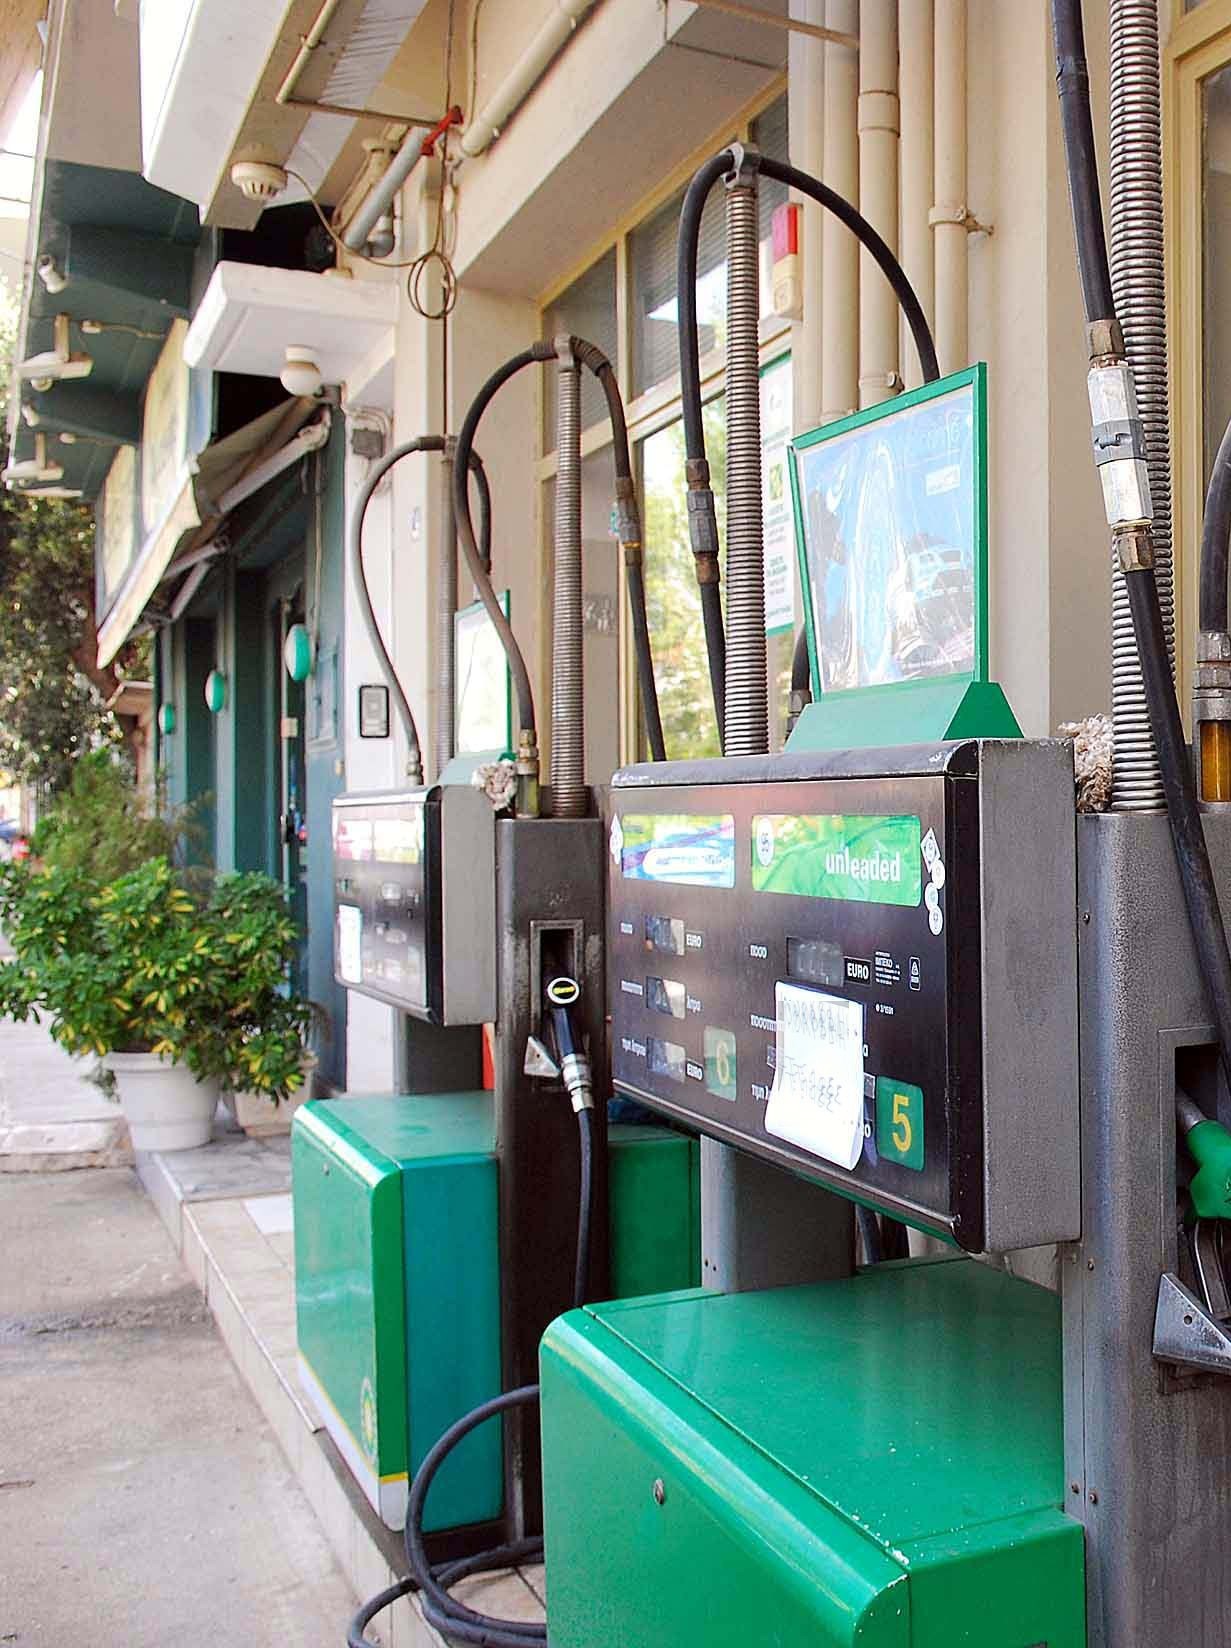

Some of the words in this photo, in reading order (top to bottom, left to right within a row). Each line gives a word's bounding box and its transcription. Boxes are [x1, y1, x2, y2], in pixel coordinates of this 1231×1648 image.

[826, 847, 901, 882] unleaded
[847, 962, 869, 980] EURO
[892, 1094, 912, 1152] 5
